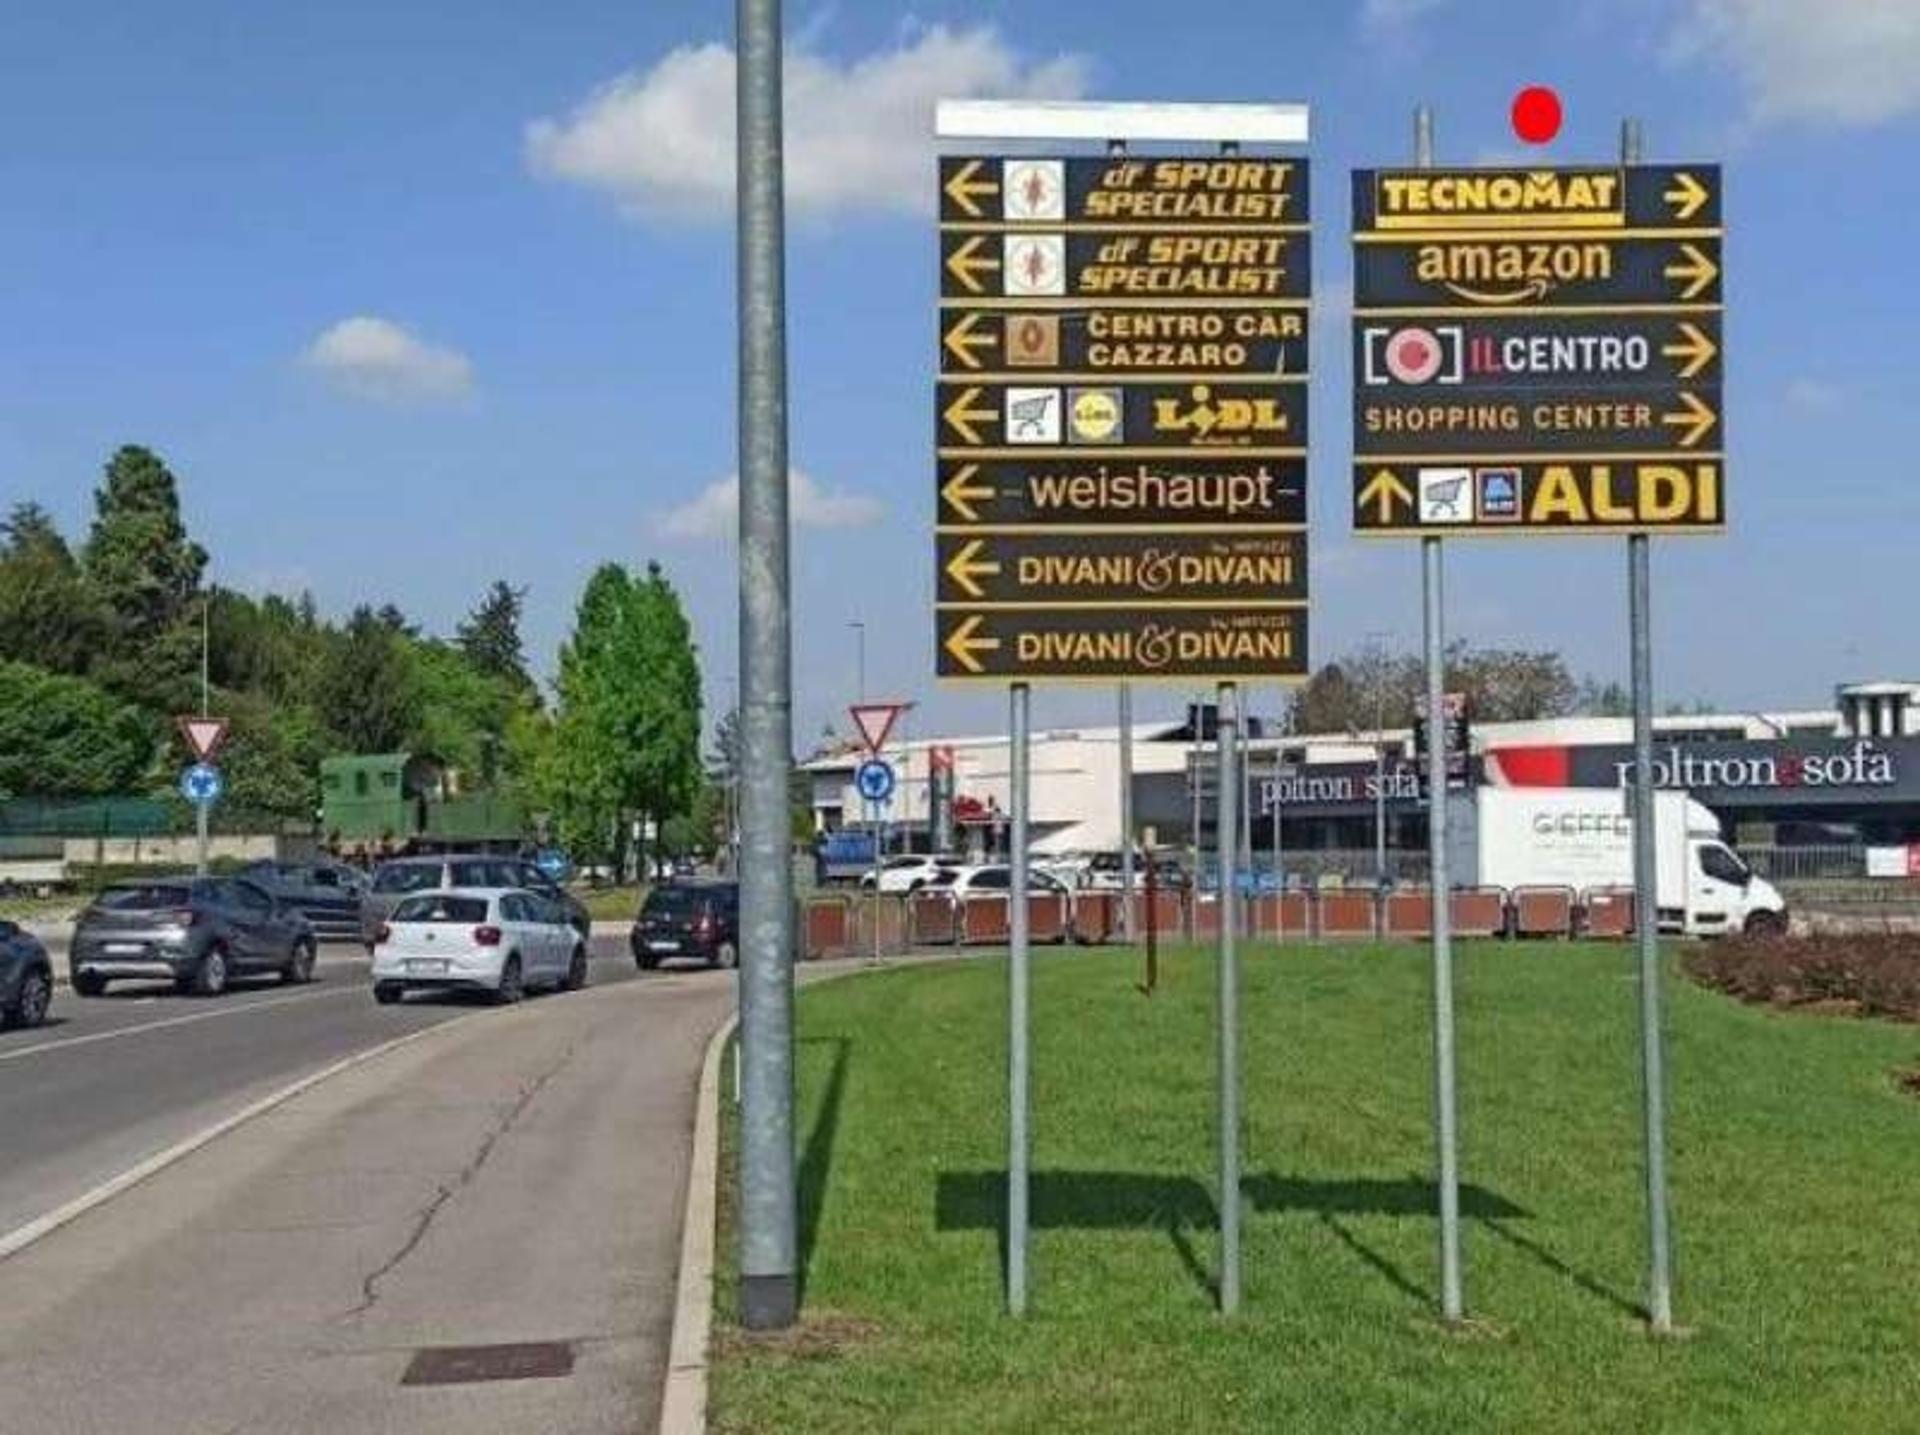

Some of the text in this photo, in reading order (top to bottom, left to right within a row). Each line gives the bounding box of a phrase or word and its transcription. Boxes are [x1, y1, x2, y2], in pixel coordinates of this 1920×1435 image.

[1153, 162, 1293, 190] SPORT
[1084, 192, 1290, 218] SPECIALIST
[1382, 171, 1616, 211] TECNOMAT
[1148, 238, 1286, 265] SPORT
[1416, 243, 1611, 282] amazon
[1079, 268, 1286, 293] SPECIALIST
[1087, 314, 1302, 338] CENTRO CAR
[1087, 344, 1247, 367] CAZZARO
[1365, 404, 1652, 432] SHOPPING CENTER
[1029, 465, 1273, 515] weishaupt
[1530, 465, 1718, 522] ALDI
[1018, 556, 1132, 584] DIVANI
[1179, 556, 1292, 584] DIVANI
[1017, 632, 1132, 661] DIVANI
[1178, 632, 1291, 661] DIVANI
